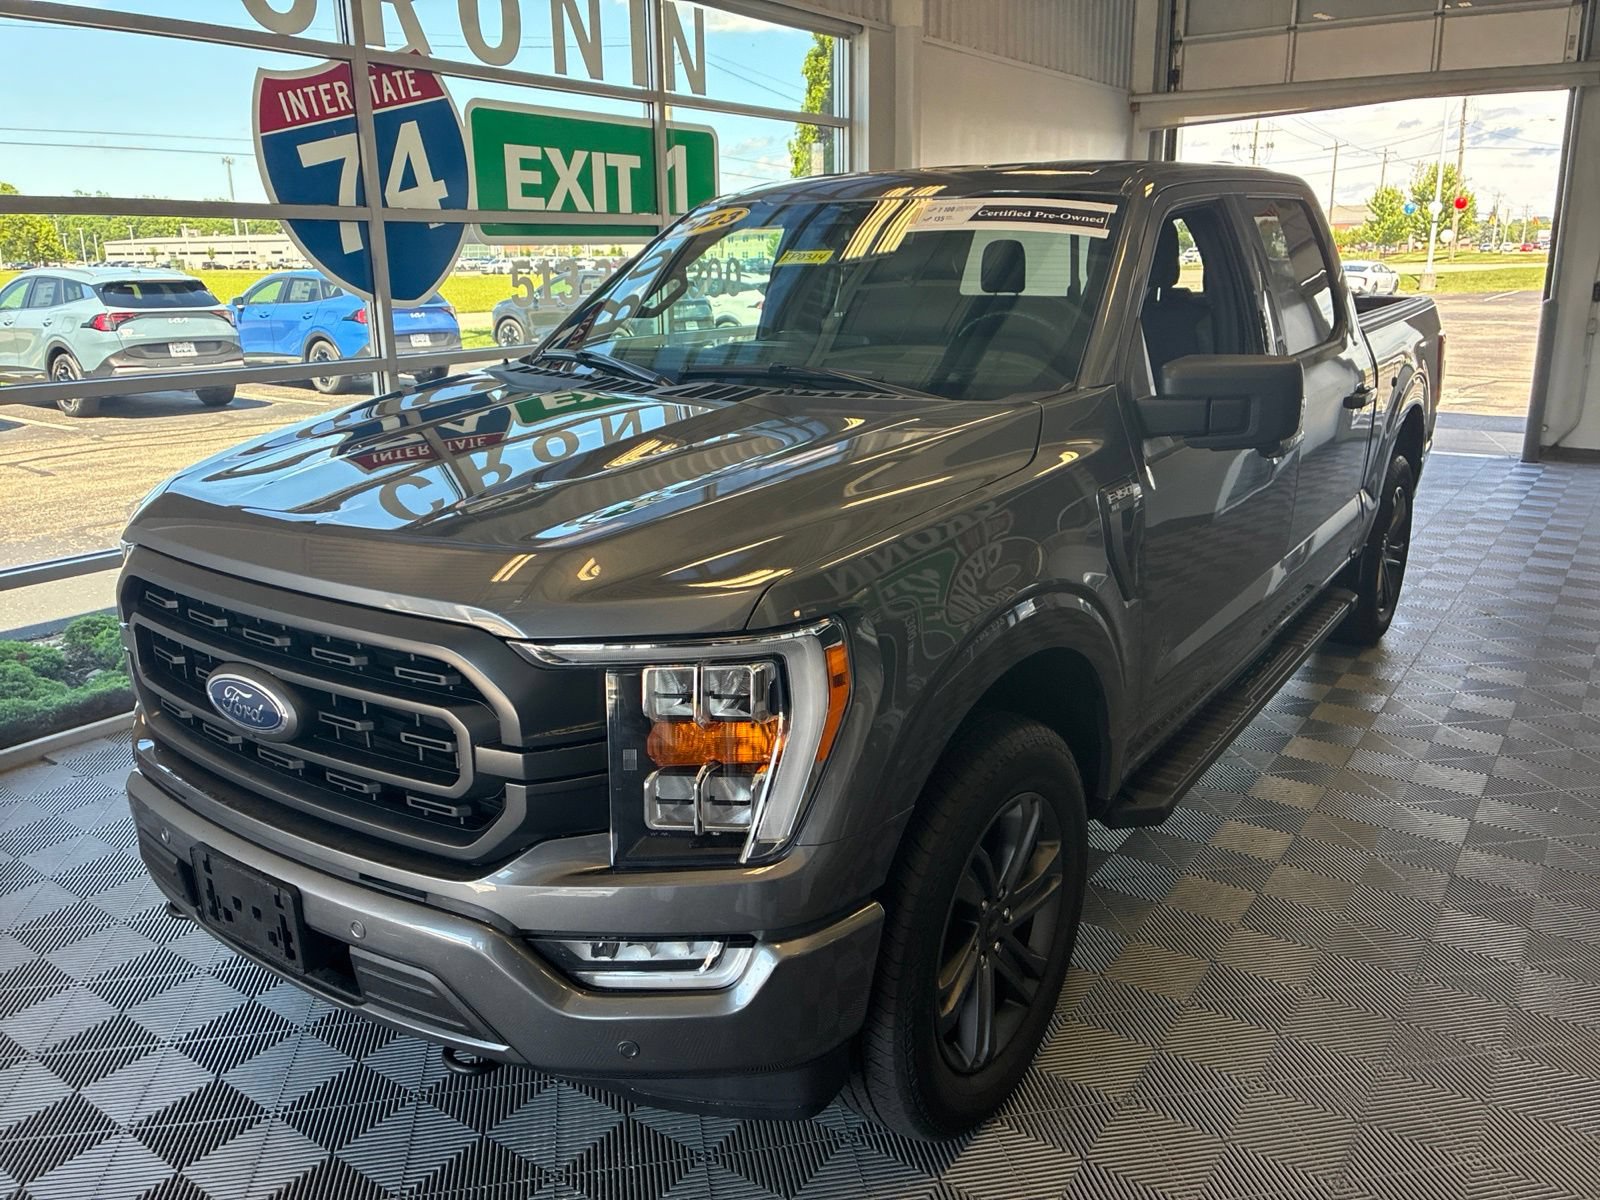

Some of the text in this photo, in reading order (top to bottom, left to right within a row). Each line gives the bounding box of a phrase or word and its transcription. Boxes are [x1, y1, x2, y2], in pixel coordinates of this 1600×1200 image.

[278, 69, 421, 122] INTERTATE
[297, 121, 448, 254] 74
[504, 144, 688, 213] EXIT 1
[977, 208, 1031, 219] Certified
[1033, 210, 1105, 224] Pre-Owned
[510, 259, 580, 309] 513
[222, 685, 264, 722] Ford
